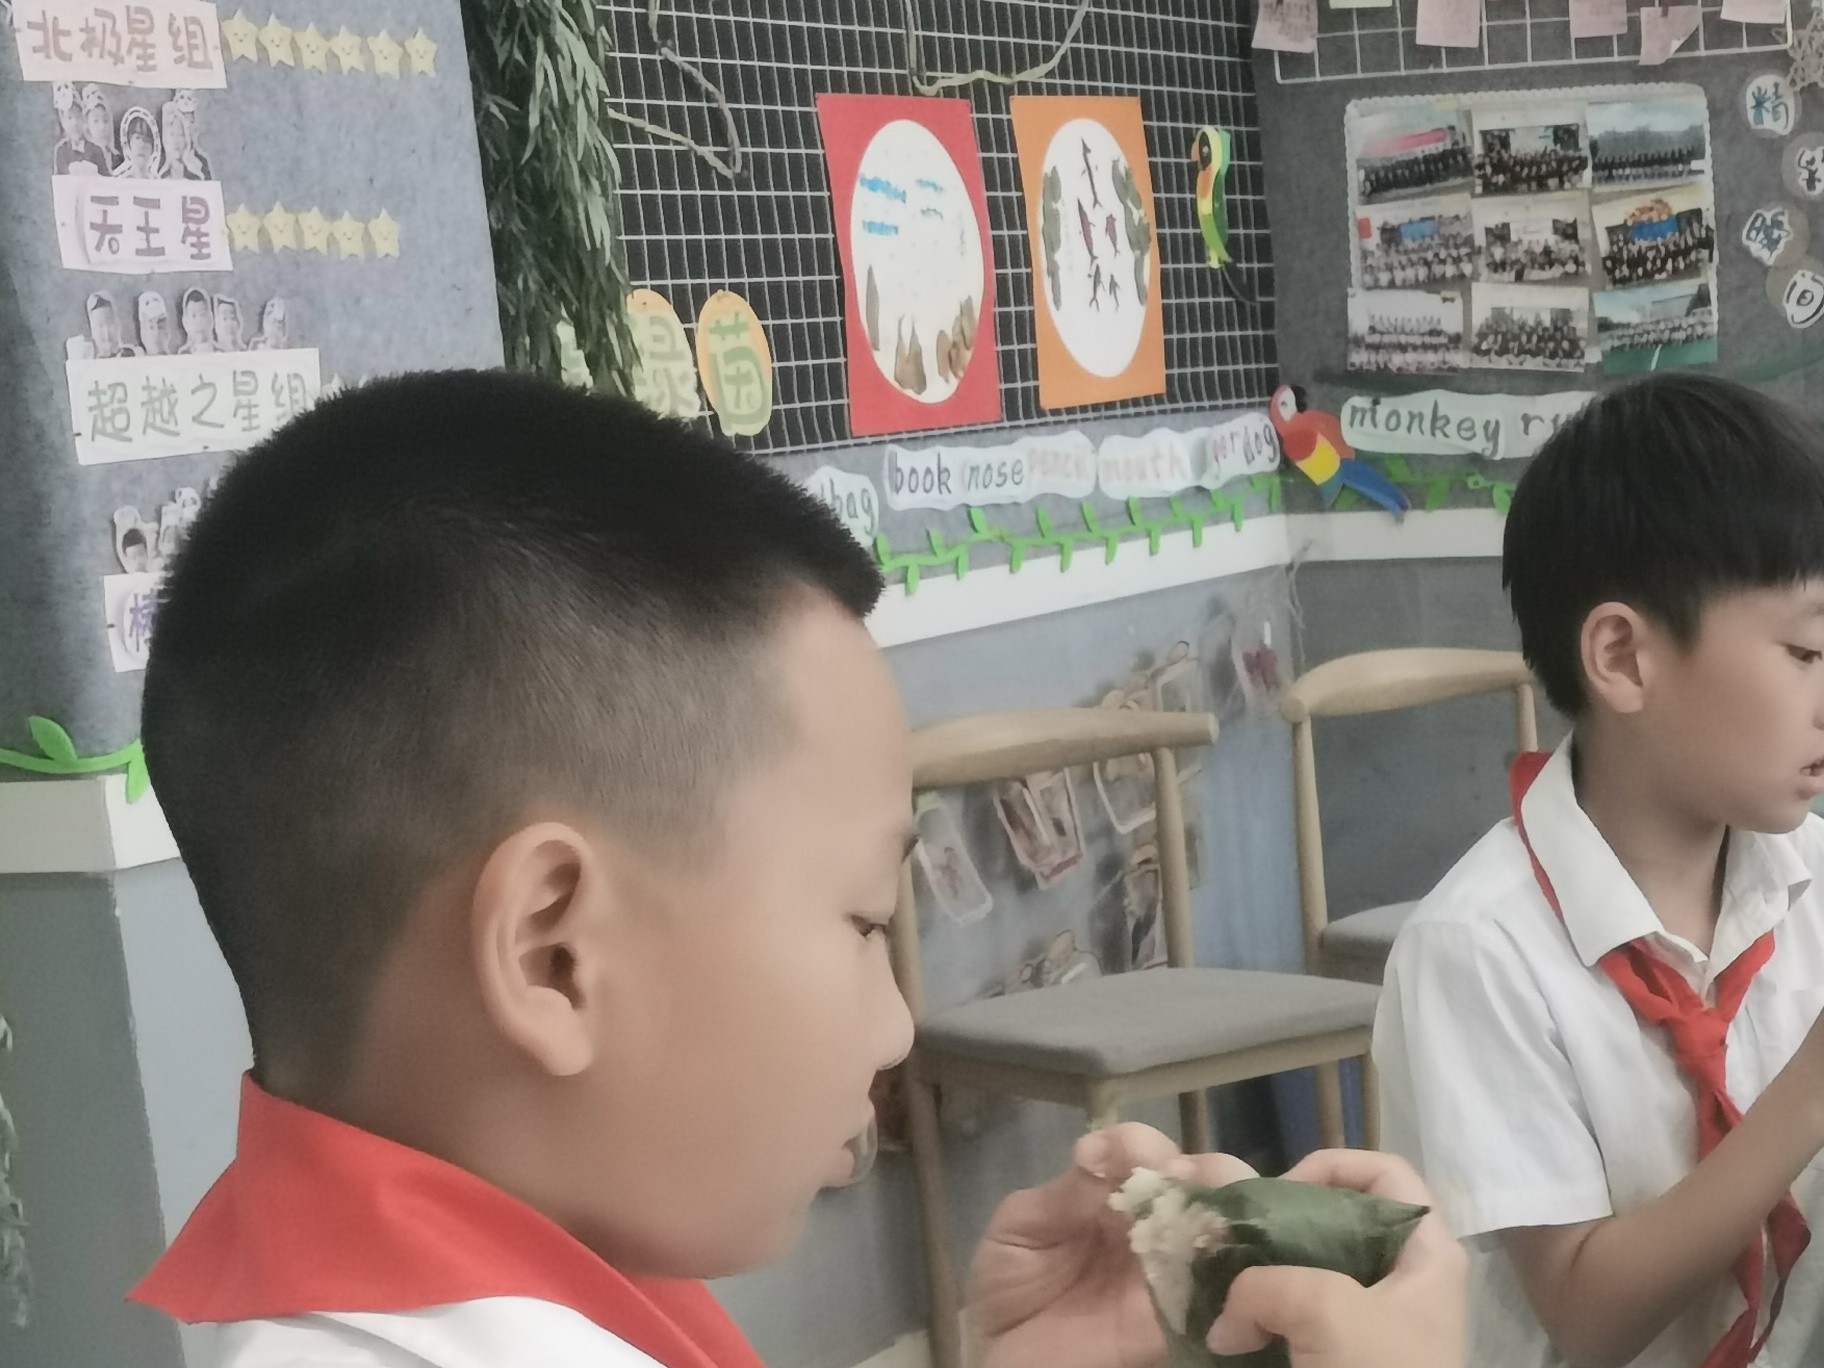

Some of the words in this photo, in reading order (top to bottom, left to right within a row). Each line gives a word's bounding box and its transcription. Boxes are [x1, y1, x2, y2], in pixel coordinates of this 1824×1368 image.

[27, 5, 213, 72] 北极星组
[889, 451, 952, 495] book
[967, 459, 1025, 492] nose
[1243, 423, 1277, 465] dog
[1350, 399, 1501, 458] monkey
